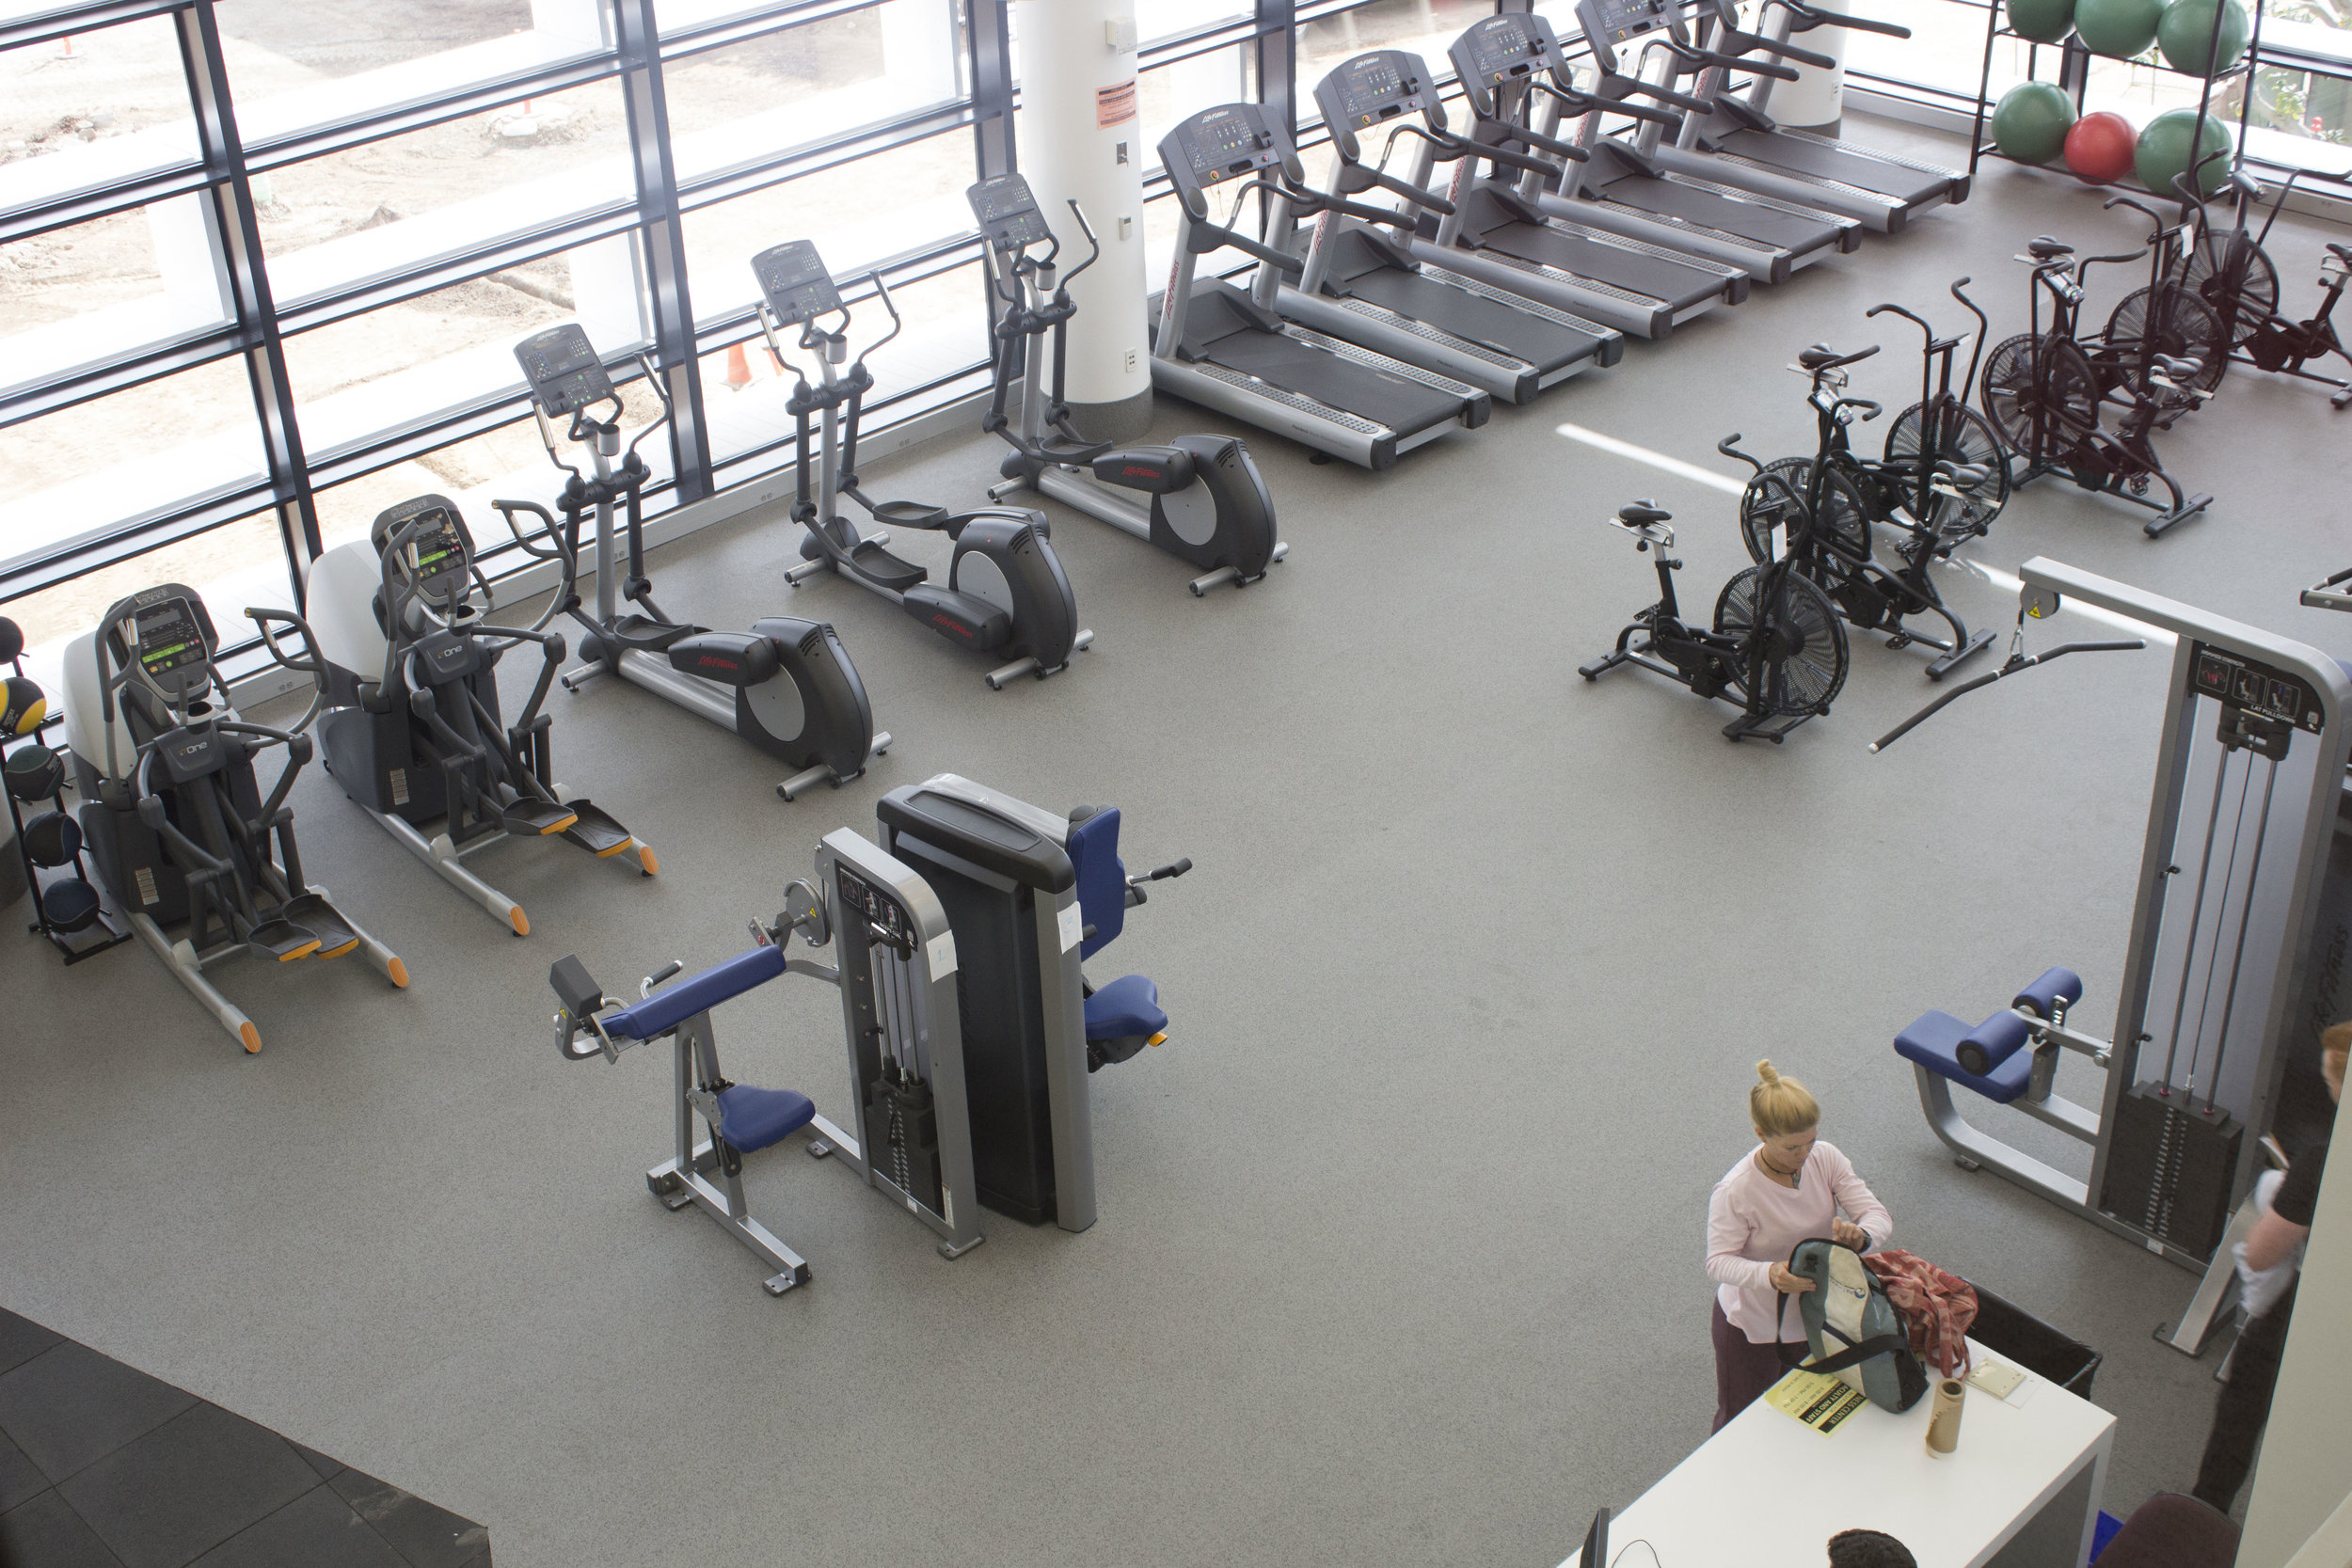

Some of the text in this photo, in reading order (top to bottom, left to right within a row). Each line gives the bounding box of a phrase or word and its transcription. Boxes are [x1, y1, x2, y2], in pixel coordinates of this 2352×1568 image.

[2250, 703, 2262, 711] LAT
[1829, 1384, 1849, 1402] ACULTY
[1818, 1399, 1831, 1410] AND
[1847, 1394, 1863, 1408] NESS
[1805, 1408, 1821, 1422] STAFF
[1829, 1405, 1850, 1424] CENTER
